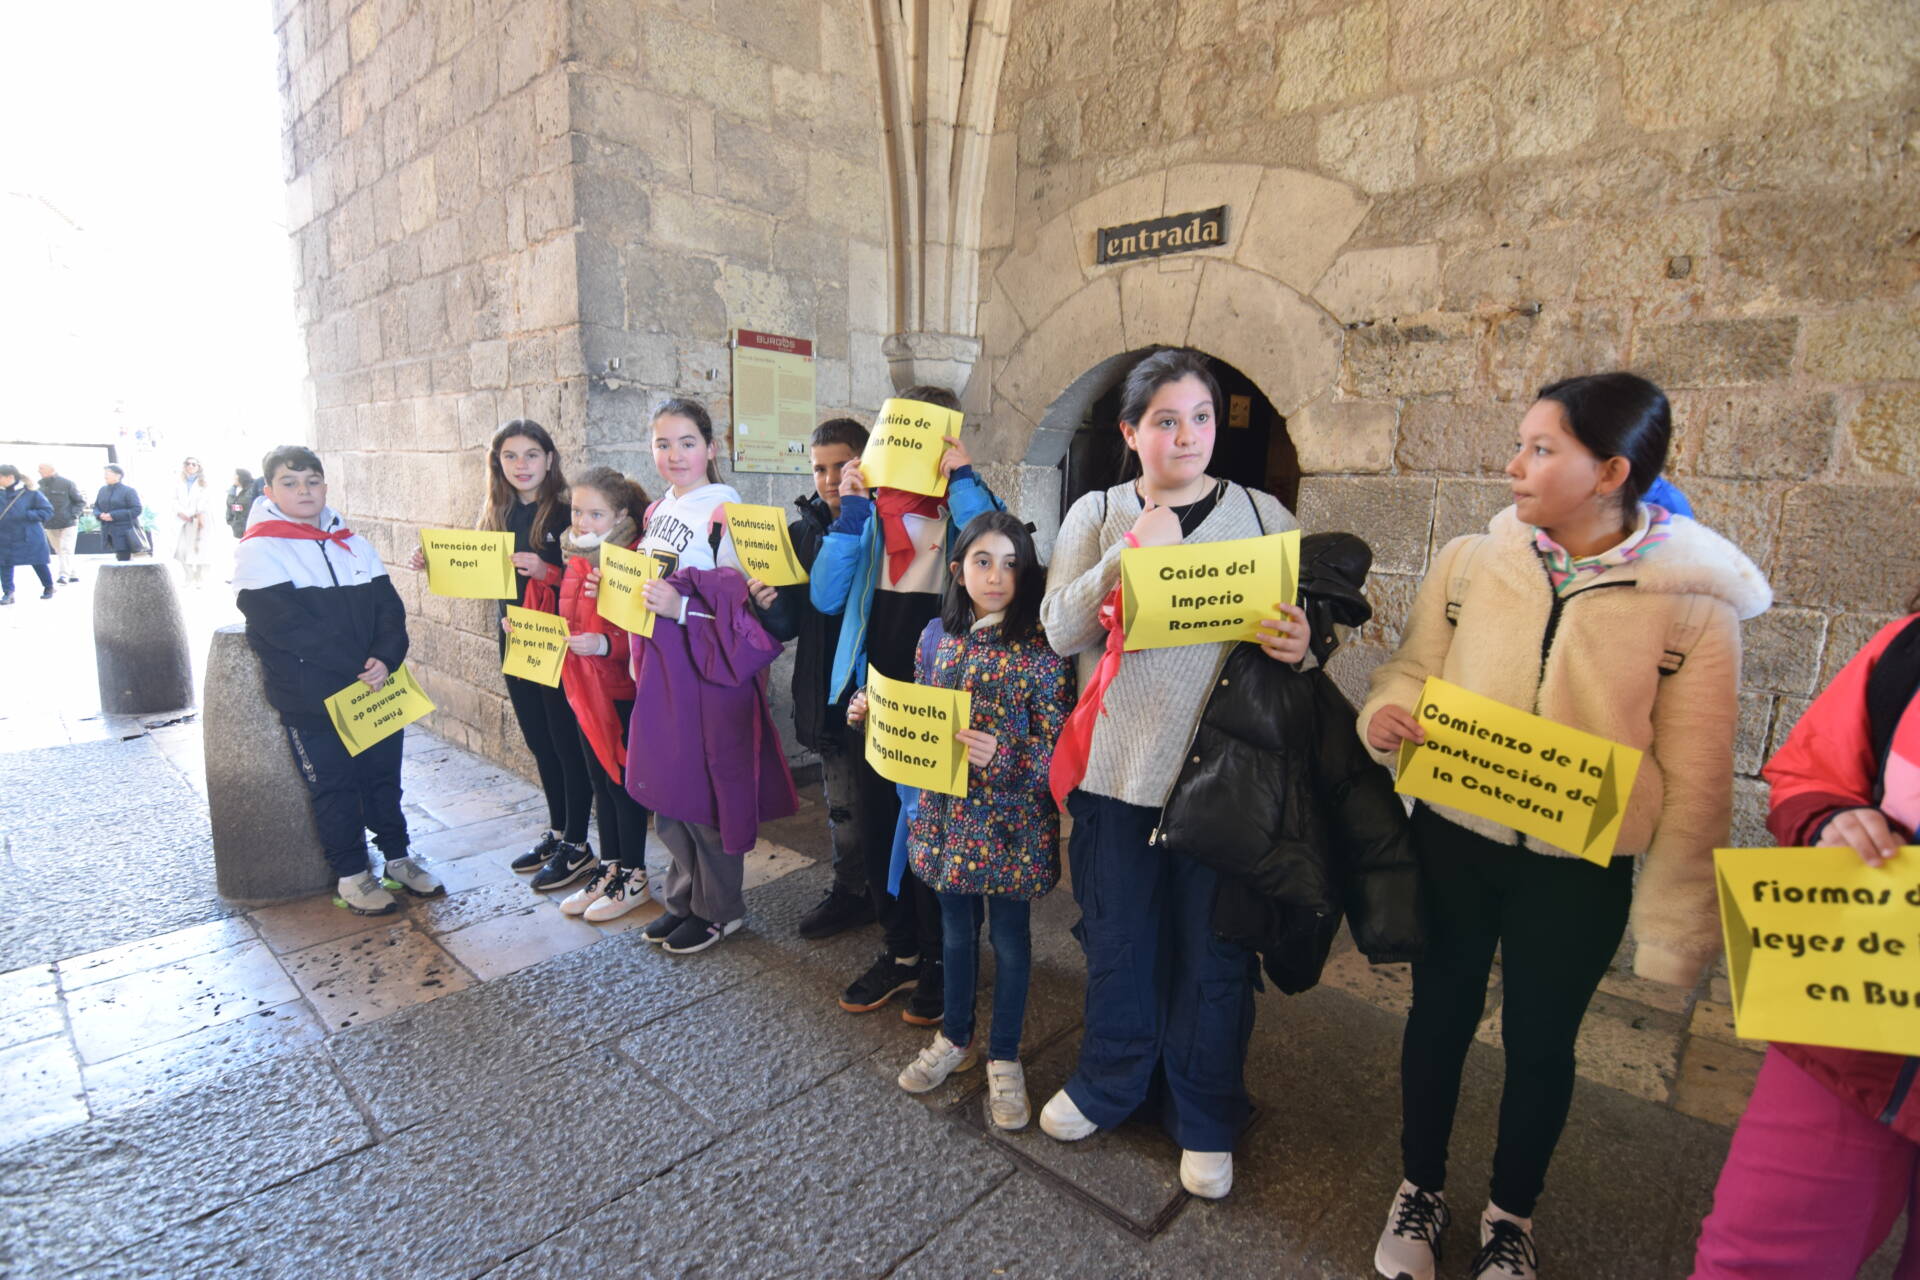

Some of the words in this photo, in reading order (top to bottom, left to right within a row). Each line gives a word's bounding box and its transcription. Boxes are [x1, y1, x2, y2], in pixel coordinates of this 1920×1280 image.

[1106, 217, 1219, 257] entrada
[914, 418, 931, 430] de
[887, 435, 923, 450] Pablo
[648, 514, 694, 553] WARTS
[480, 543, 497, 552] del
[449, 558, 478, 569] Papel
[747, 557, 770, 571] Egipto
[1159, 564, 1219, 581] Caída
[1225, 559, 1256, 577] del
[608, 577, 616, 588] de
[1171, 590, 1244, 610] Imperio
[524, 621, 534, 631] de
[1169, 617, 1244, 631] Romano
[523, 639, 536, 648] por
[538, 641, 545, 650] el
[526, 654, 542, 668] Rojo
[869, 685, 899, 712] Primera
[902, 703, 947, 721] vuelta
[352, 711, 365, 721] de
[373, 707, 403, 728] Primer
[878, 720, 916, 740] mundo
[920, 730, 940, 744] de
[1423, 703, 1533, 755] Comienzo
[1540, 748, 1571, 767] de
[1579, 758, 1604, 779] la
[872, 735, 937, 769] Magallanes
[1432, 767, 1453, 784] la
[1460, 775, 1565, 823] Catedral
[1565, 788, 1598, 807] de
[1752, 880, 1891, 905] Fiormas
[1905, 884, 1920, 906] d
[1751, 927, 1844, 958] leyes
[1858, 932, 1906, 956] de
[1806, 983, 1850, 1003] en
